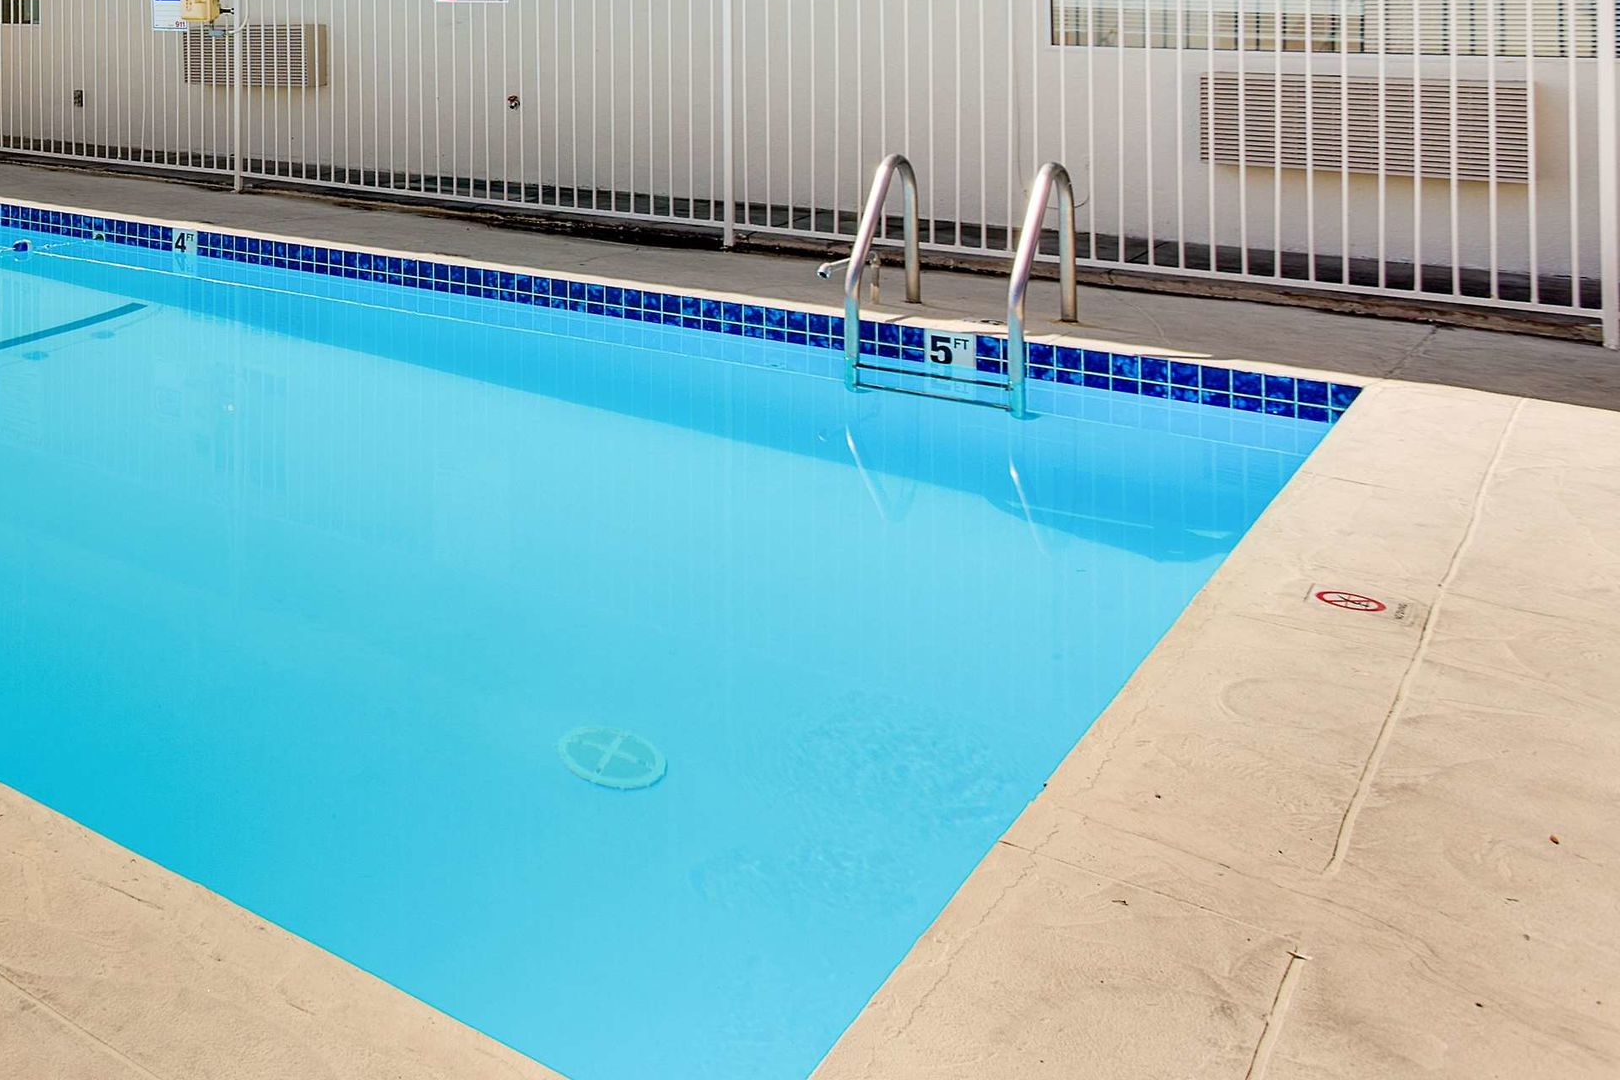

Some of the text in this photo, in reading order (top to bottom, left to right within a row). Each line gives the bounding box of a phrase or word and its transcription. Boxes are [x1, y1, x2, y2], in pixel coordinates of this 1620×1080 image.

[174, 232, 195, 253] 4 FT
[930, 335, 970, 365] 5 FT
